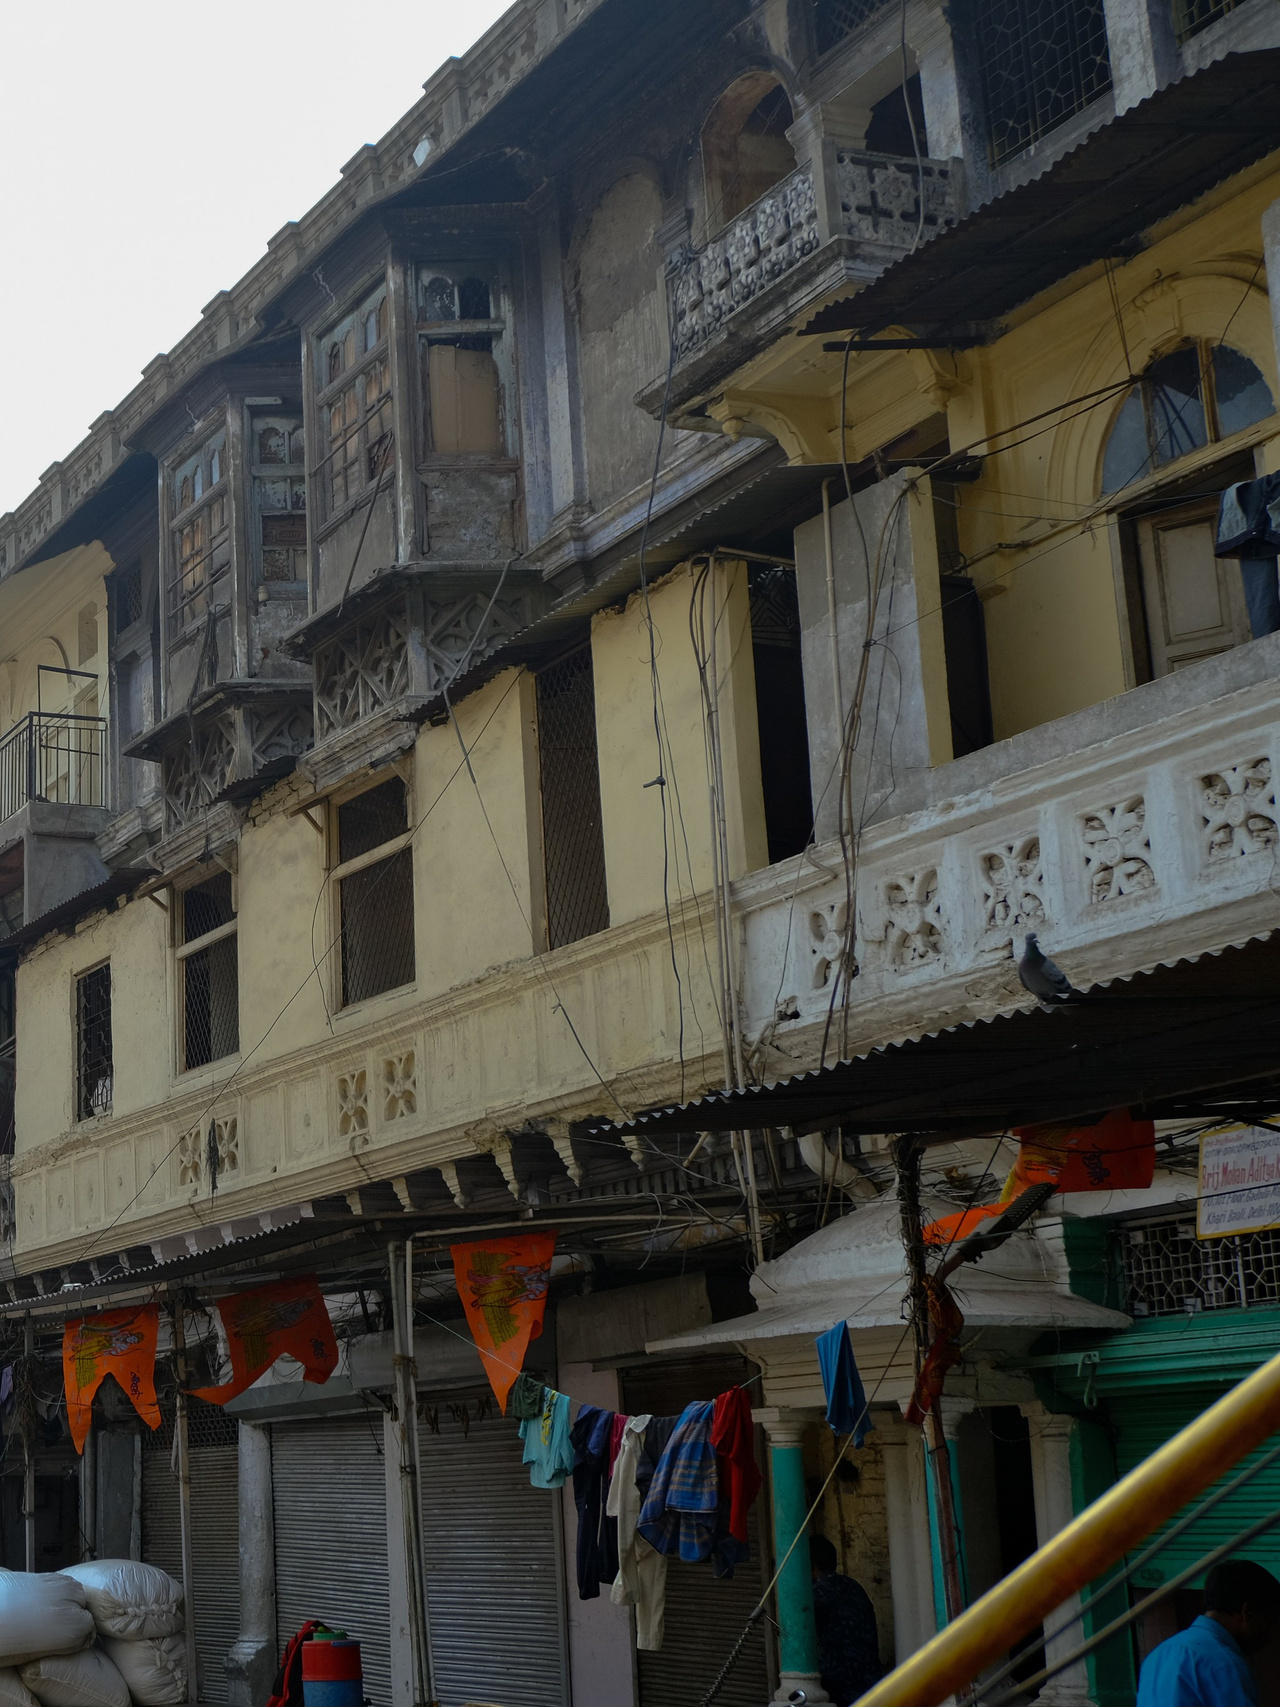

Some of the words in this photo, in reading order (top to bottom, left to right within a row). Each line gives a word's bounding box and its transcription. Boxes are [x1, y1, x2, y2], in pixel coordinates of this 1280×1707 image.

[1202, 1164, 1219, 1190] Brij
[1221, 1160, 1246, 1186] Mohan
[1247, 1155, 1275, 1182] Aditya
[1206, 1209, 1227, 1224] Khari
